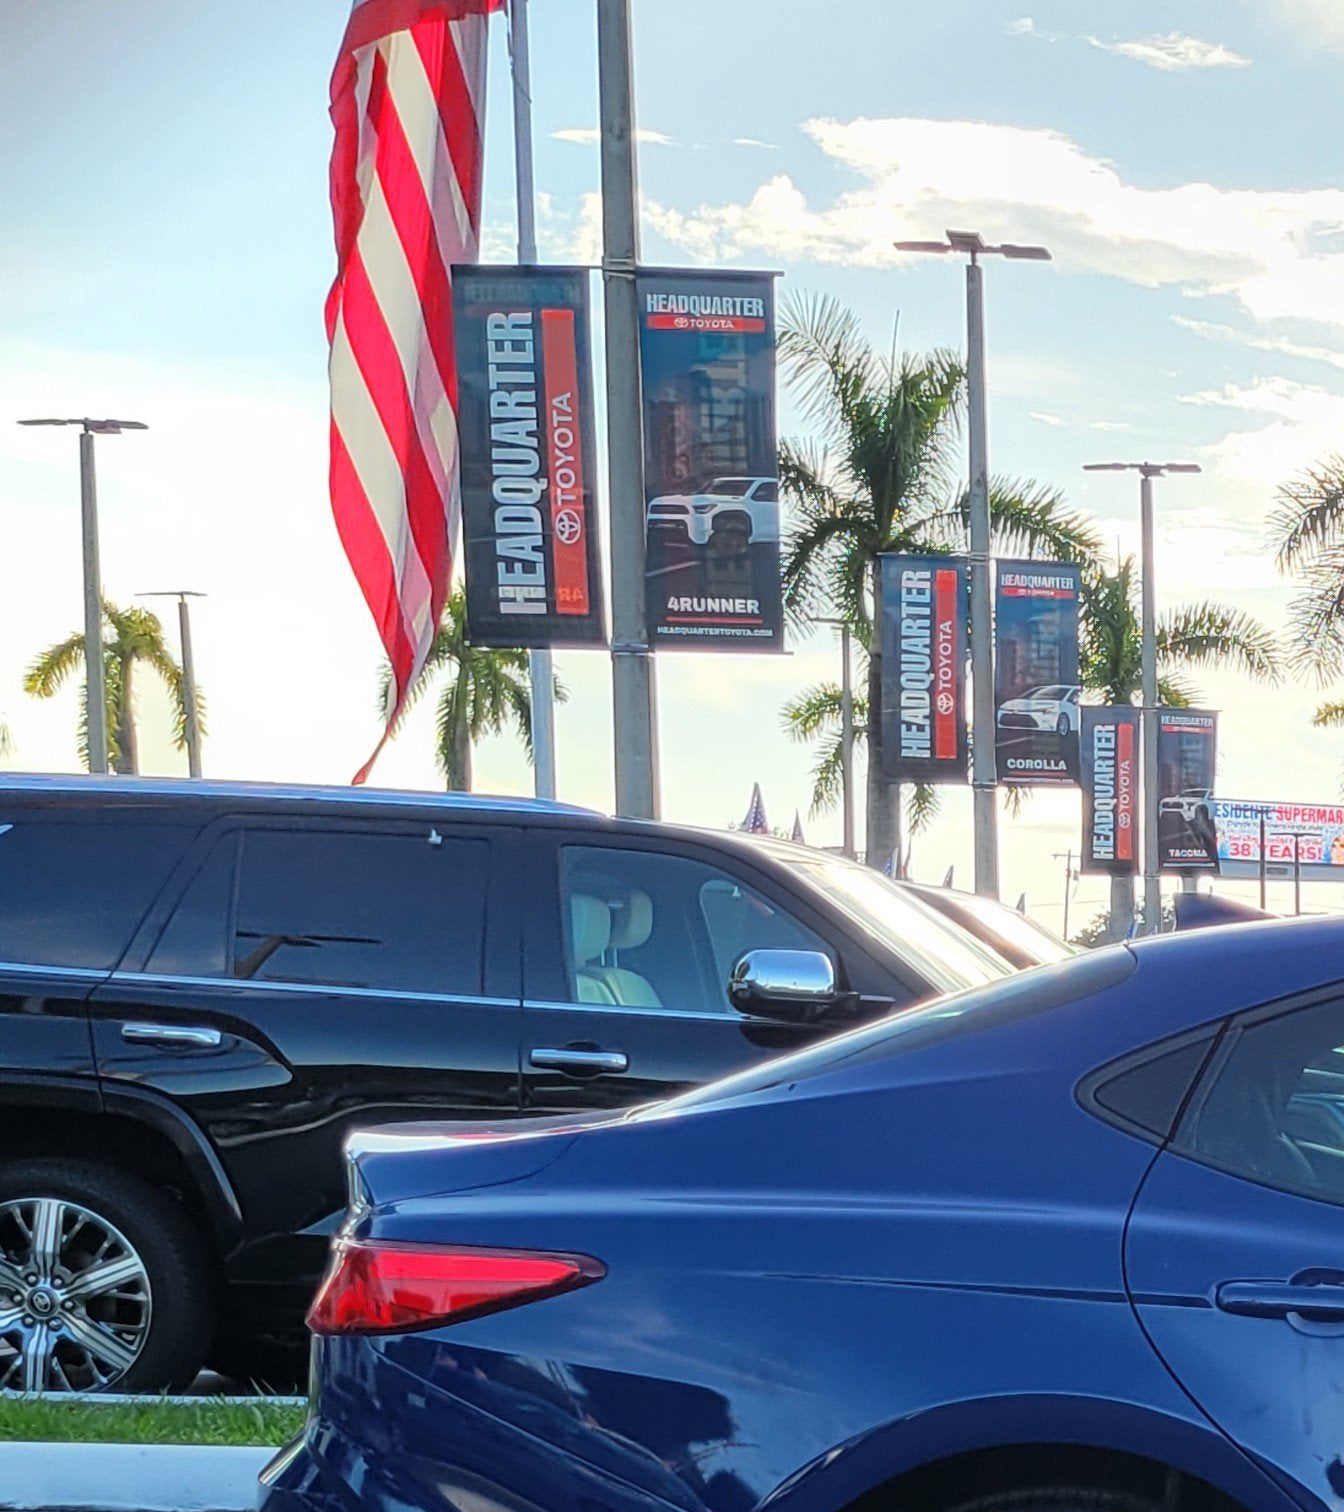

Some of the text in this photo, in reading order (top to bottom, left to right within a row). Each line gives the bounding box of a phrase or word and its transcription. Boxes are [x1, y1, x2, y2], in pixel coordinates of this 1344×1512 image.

[646, 293, 764, 317] HEADQUARTER
[690, 318, 734, 329] TOYOTA
[552, 392, 577, 506] TOYOTA
[487, 311, 548, 614] HEADQUARTER
[1001, 573, 1074, 589] HEADQUARTER
[667, 596, 760, 614] 4RUNNER
[901, 570, 934, 758] HEADQUARTER
[939, 620, 952, 690] TOYOTA
[1006, 757, 1067, 770] COROLLA
[1093, 725, 1117, 859] HEADQUARTER
[1119, 760, 1130, 812] TOYOTA
[1168, 848, 1208, 858] TACOMA
[1229, 842, 1251, 858] 38
